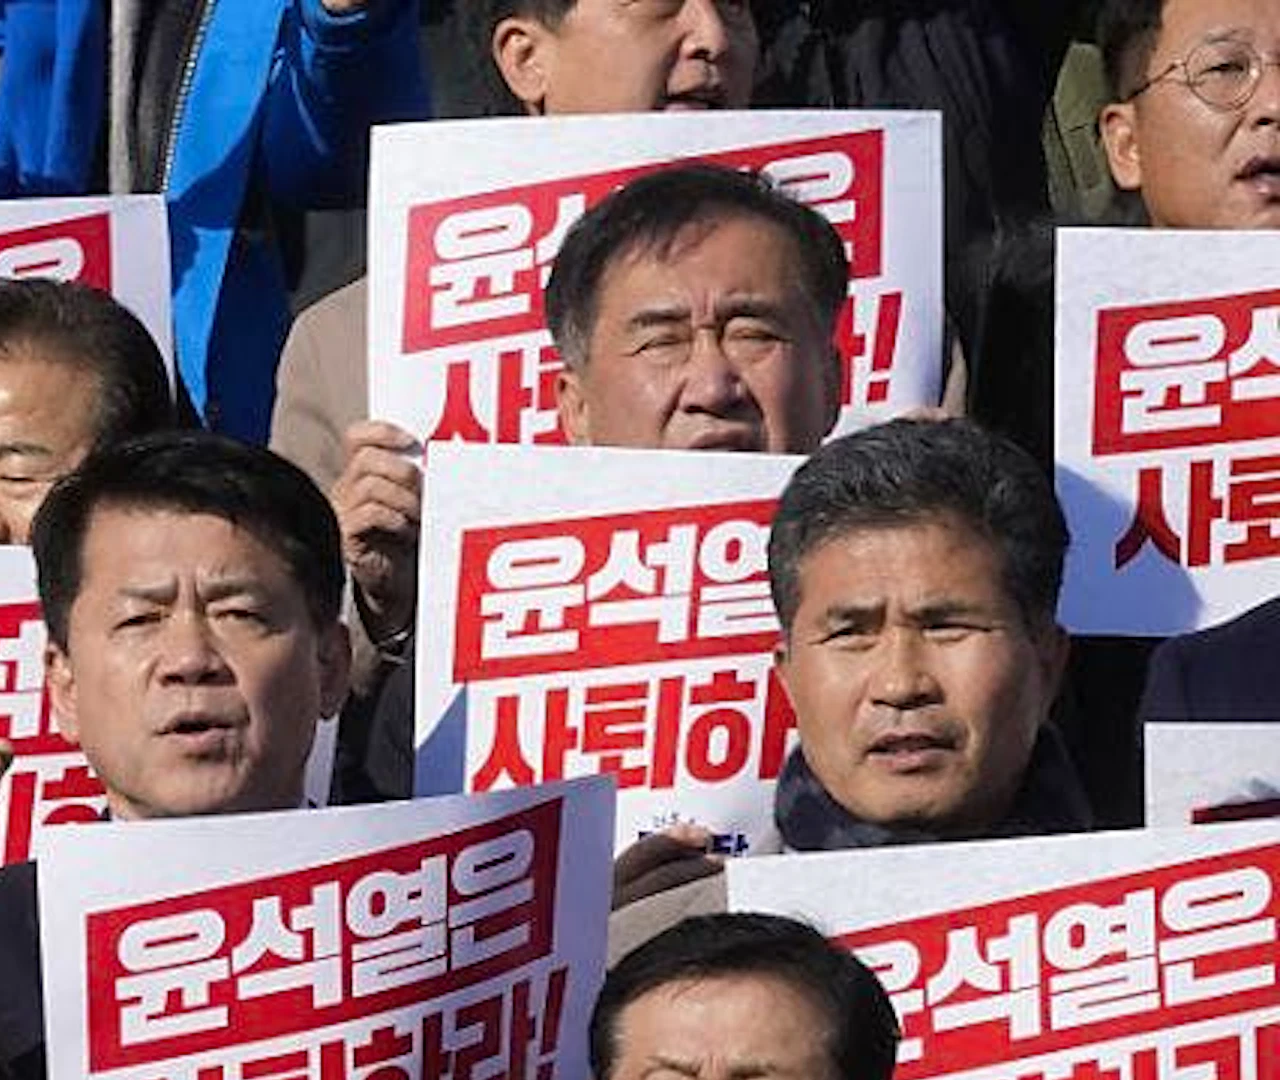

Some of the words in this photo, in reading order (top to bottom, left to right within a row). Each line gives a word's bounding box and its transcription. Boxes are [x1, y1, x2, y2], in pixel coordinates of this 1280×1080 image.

[480, 520, 782, 660] 윤석열
[470, 667, 798, 793] 사퇴하
[114, 829, 535, 1047] 윤석열은
